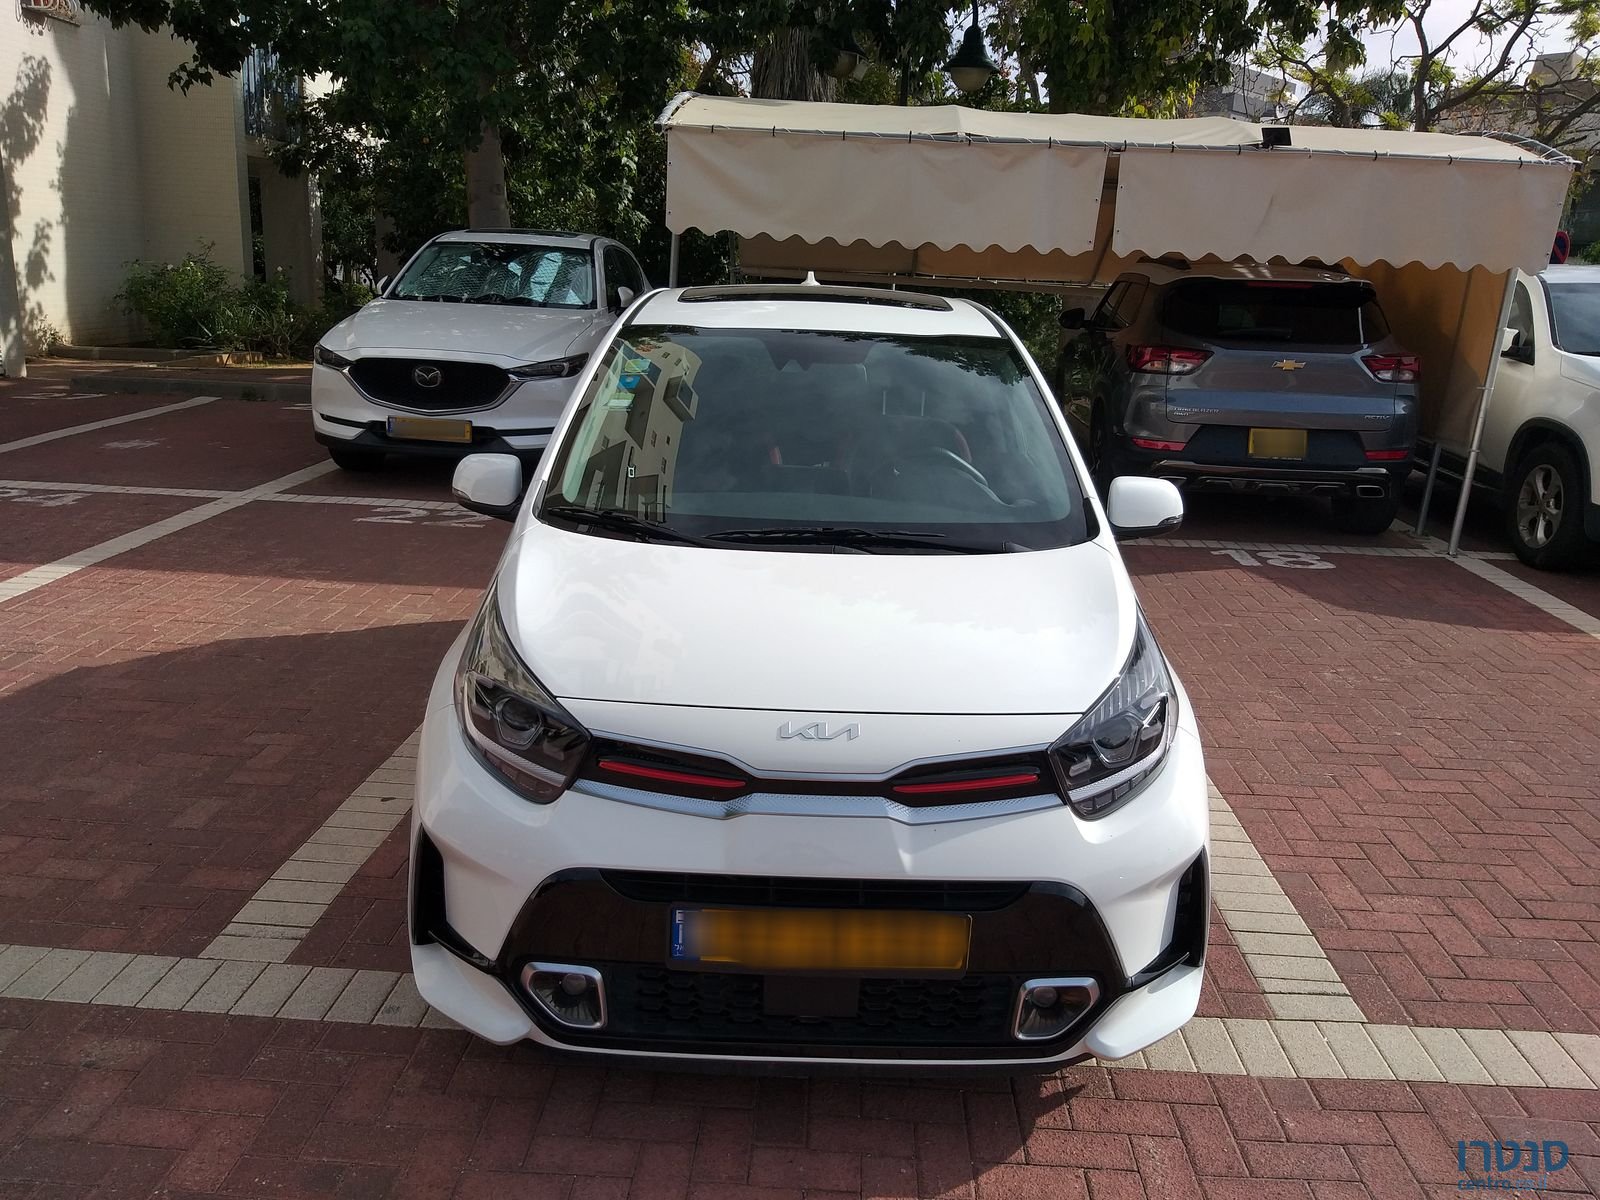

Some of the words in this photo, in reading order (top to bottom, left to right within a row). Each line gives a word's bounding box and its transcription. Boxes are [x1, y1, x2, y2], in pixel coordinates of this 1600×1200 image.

[351, 506, 495, 528] 22
[1210, 549, 1337, 570] 18
[776, 720, 861, 741] KIA
